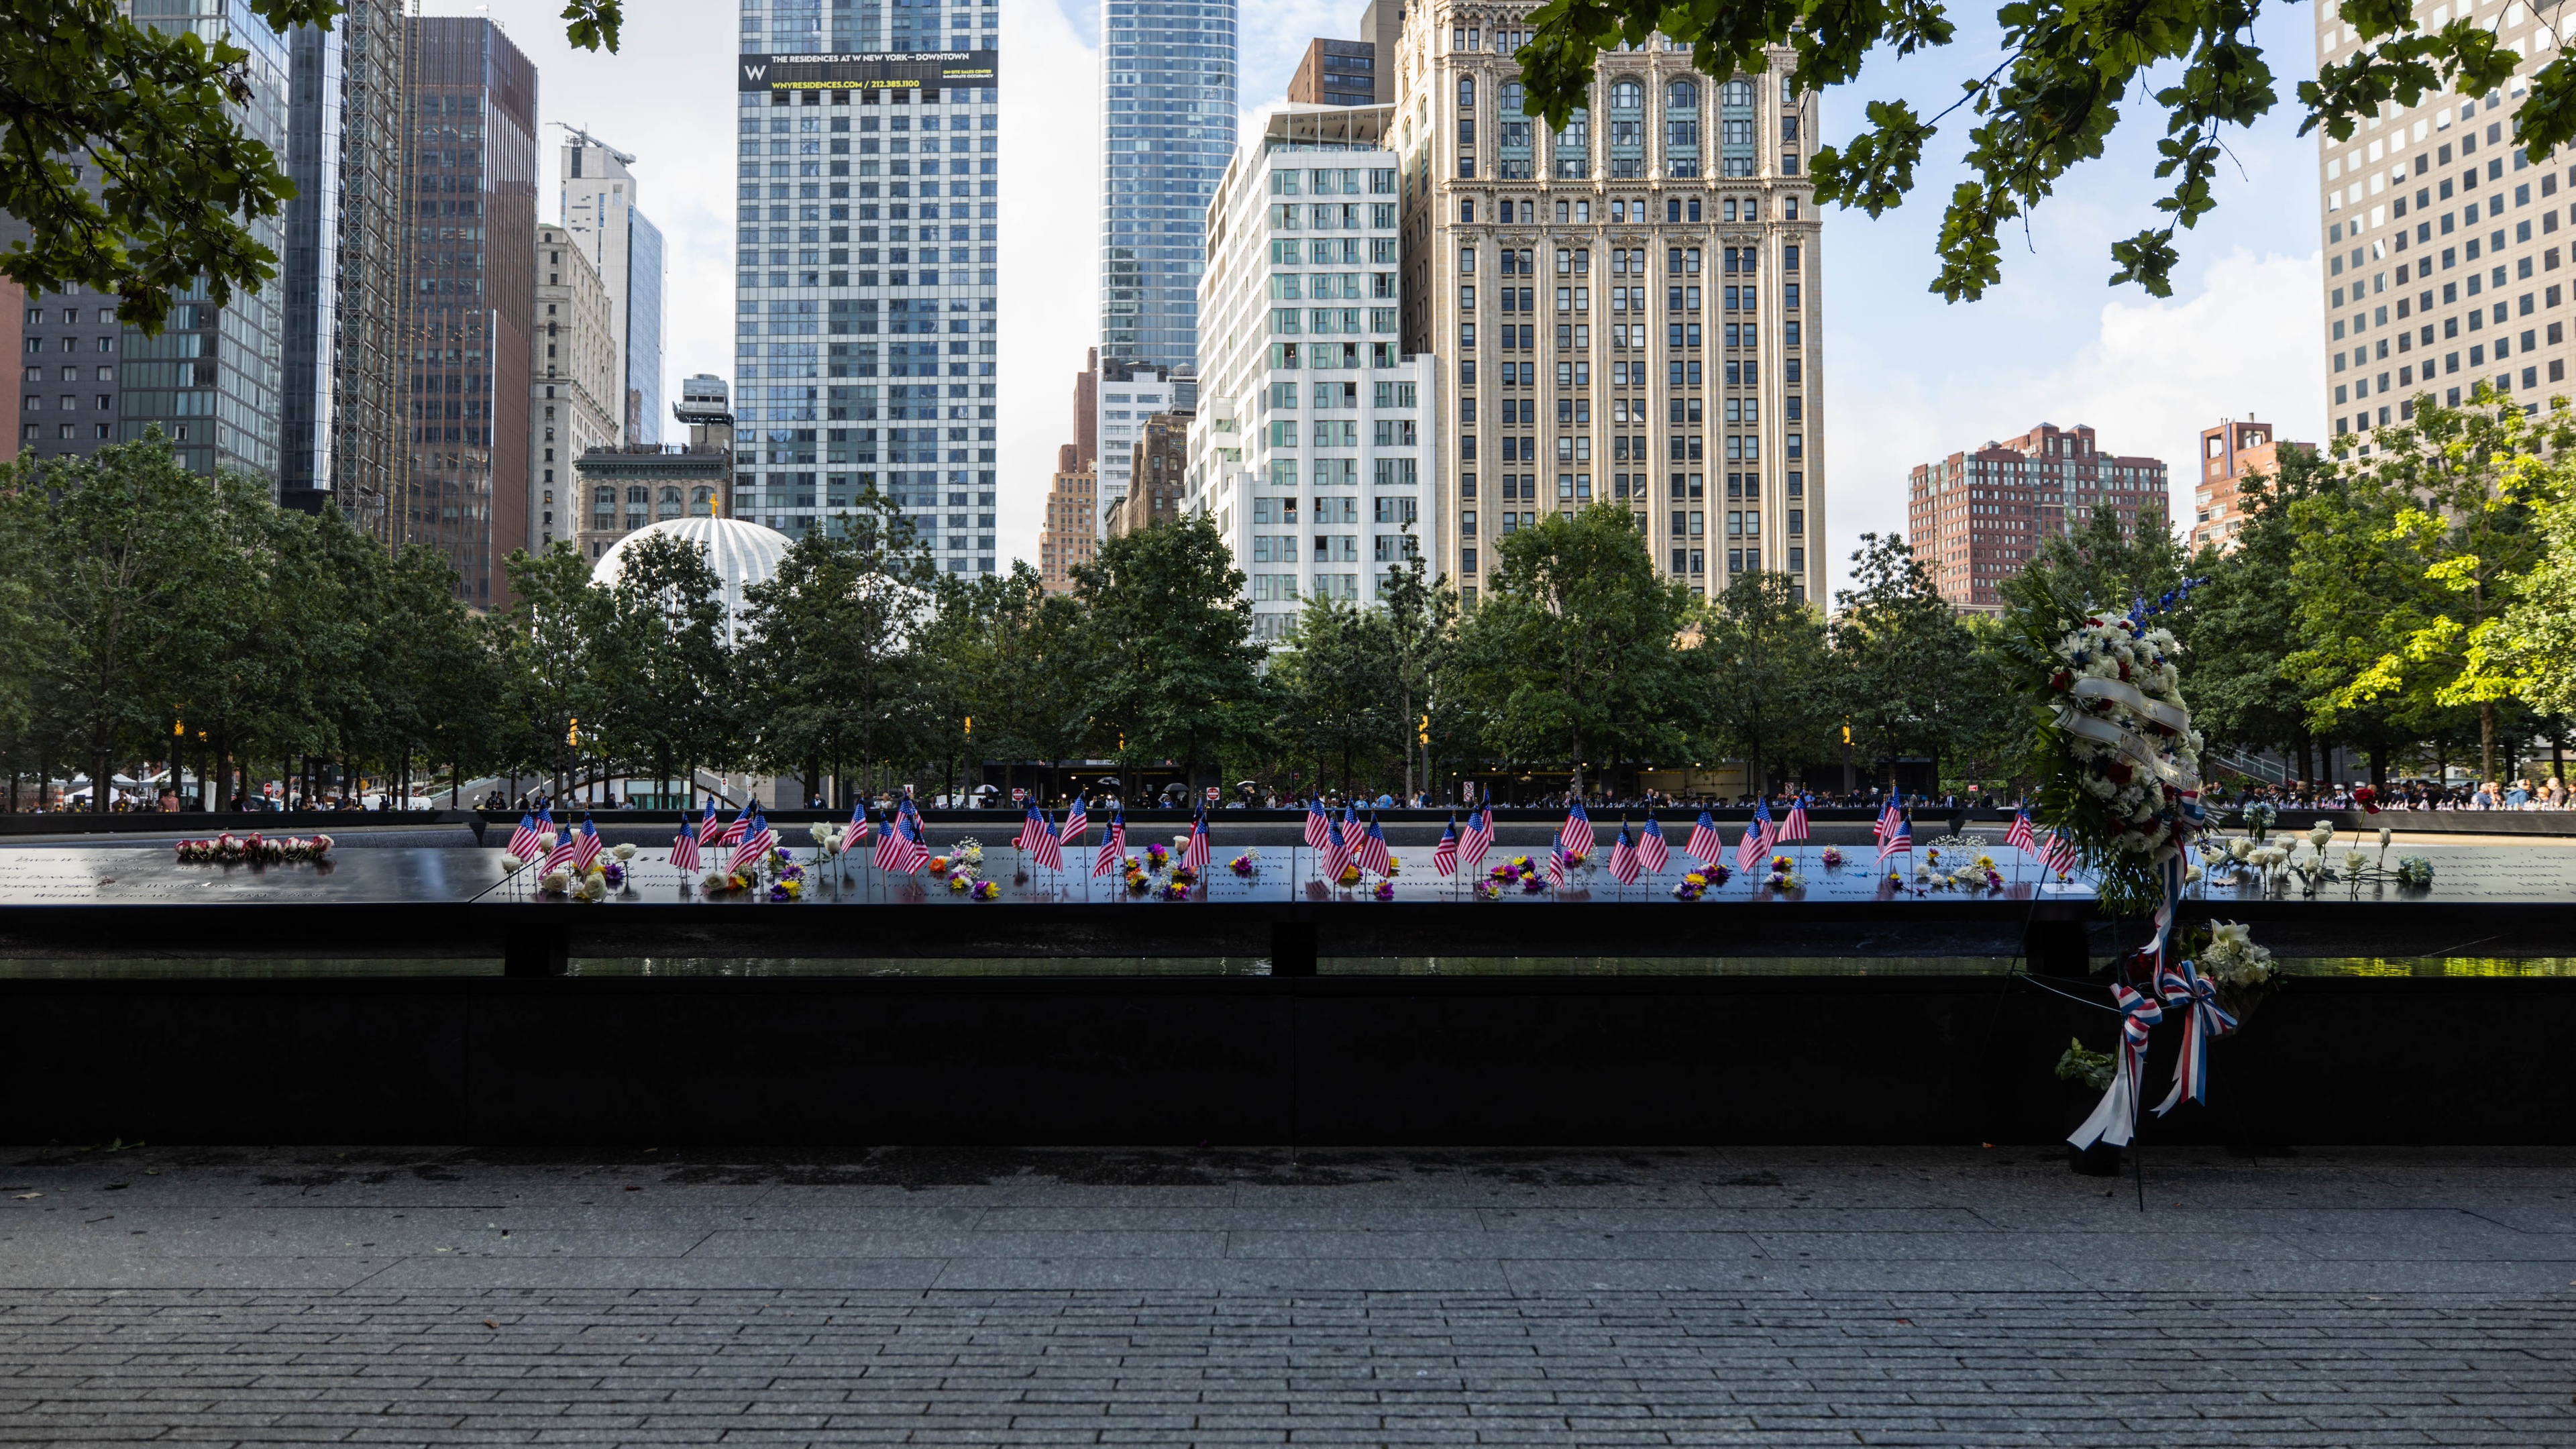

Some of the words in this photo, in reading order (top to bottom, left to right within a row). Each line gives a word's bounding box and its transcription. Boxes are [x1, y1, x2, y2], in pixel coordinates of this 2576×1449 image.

[772, 55, 788, 63] THE
[790, 55, 839, 63] RESIDENCES
[865, 54, 883, 62] NEW
[745, 65, 767, 81] W
[772, 80, 863, 89] WNYRESIDENCES.COM
[871, 80, 920, 88] 212.385.1100
